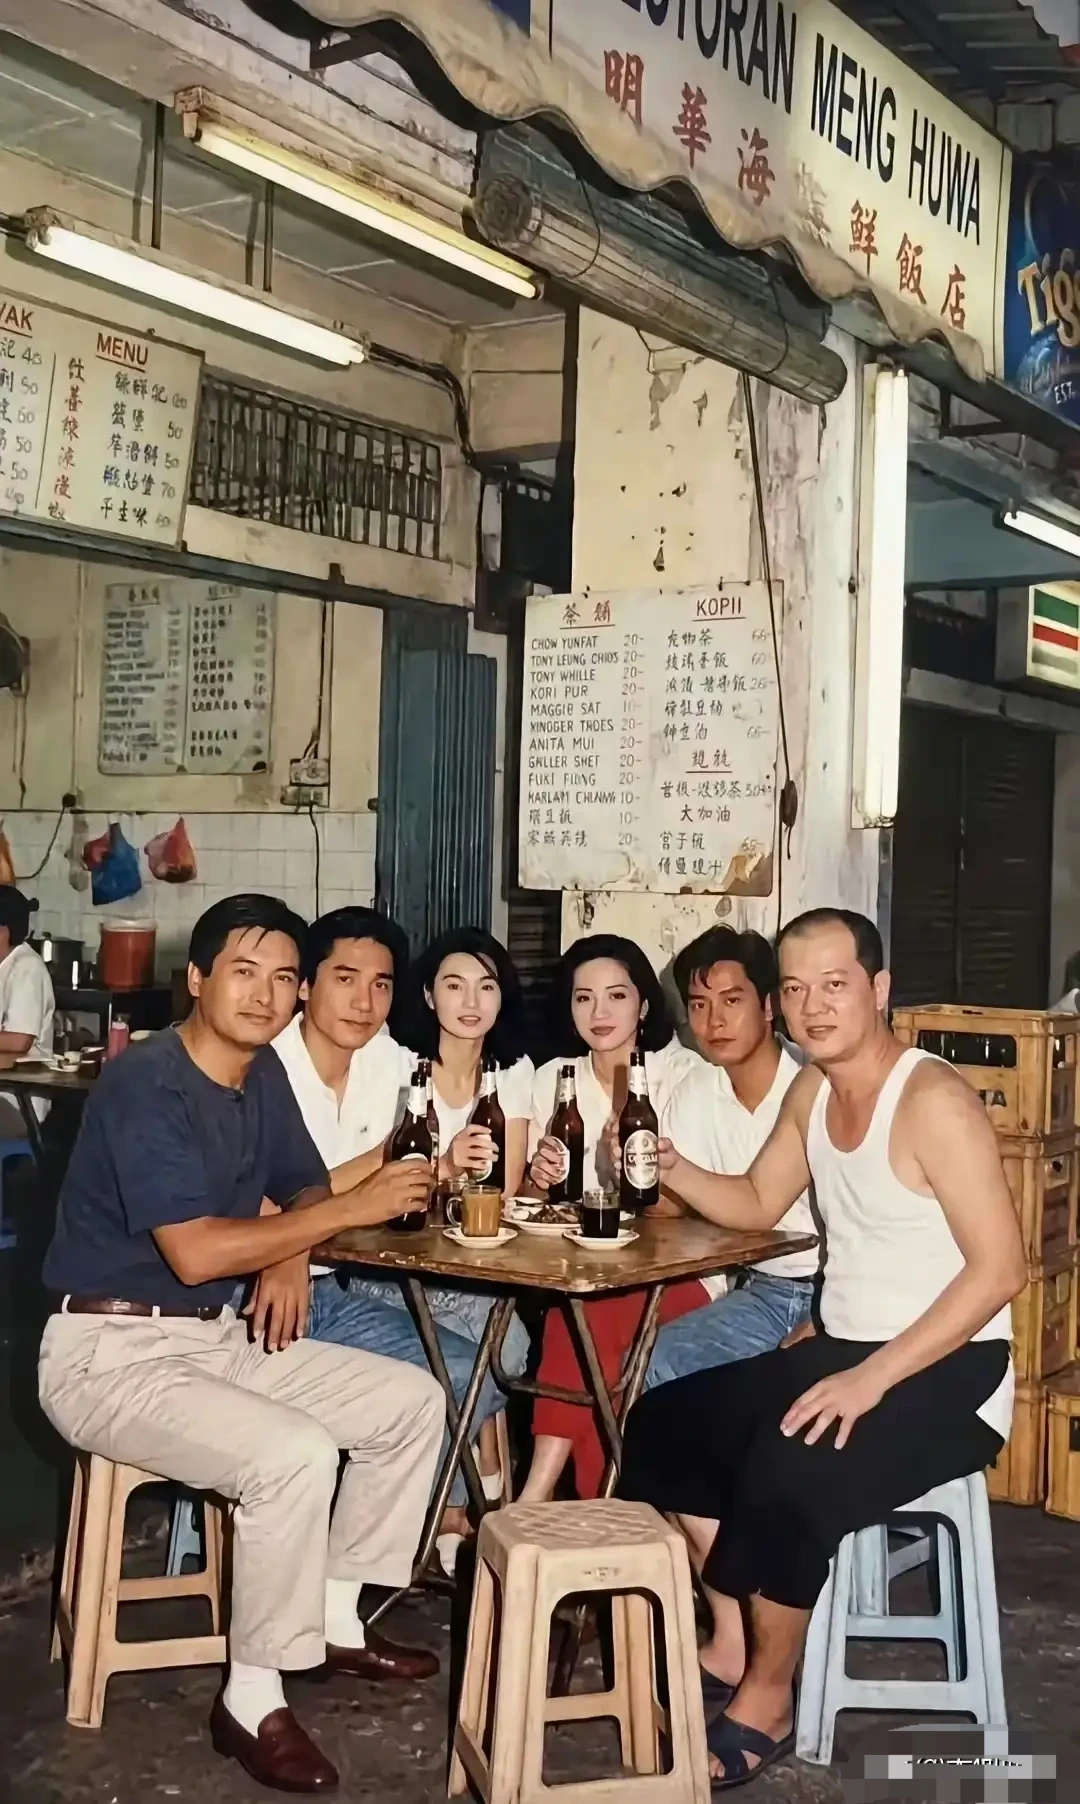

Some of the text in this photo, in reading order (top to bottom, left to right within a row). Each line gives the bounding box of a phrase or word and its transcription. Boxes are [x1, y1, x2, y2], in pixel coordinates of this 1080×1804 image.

[811, 31, 897, 184] MENG
[908, 107, 981, 247] HUWA
[0, 302, 34, 332] AK
[96, 332, 149, 366] MENU
[531, 638, 558, 651] CHOW
[561, 635, 599, 650] YUNFAT
[531, 655, 554, 667] TONY
[556, 652, 586, 667] LEUNG
[531, 670, 555, 684] TONY
[530, 686, 557, 700] KORI
[564, 685, 589, 699] PUR
[580, 701, 602, 716] SAT
[529, 737, 565, 751] ANITA
[572, 737, 595, 751] MUI
[680, 804, 731, 822] 大加油
